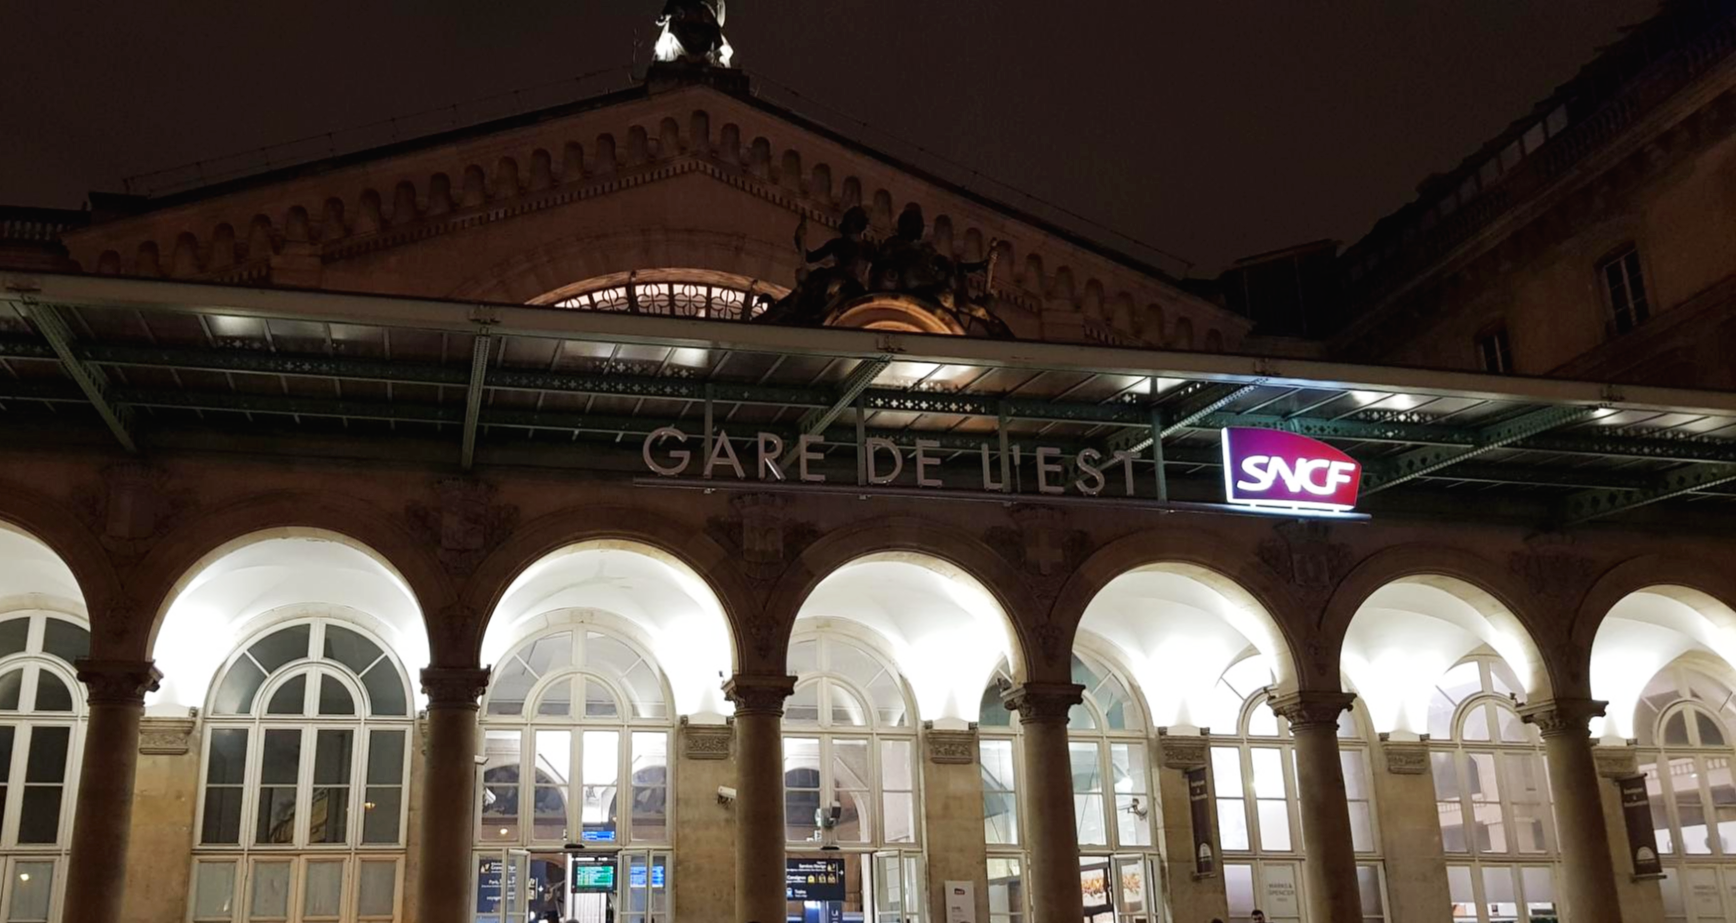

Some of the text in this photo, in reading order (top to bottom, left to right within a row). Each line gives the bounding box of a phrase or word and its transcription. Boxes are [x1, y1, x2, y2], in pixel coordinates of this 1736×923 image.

[643, 427, 1141, 496] GARE DE L'EST
[1236, 455, 1356, 496] SNCF
